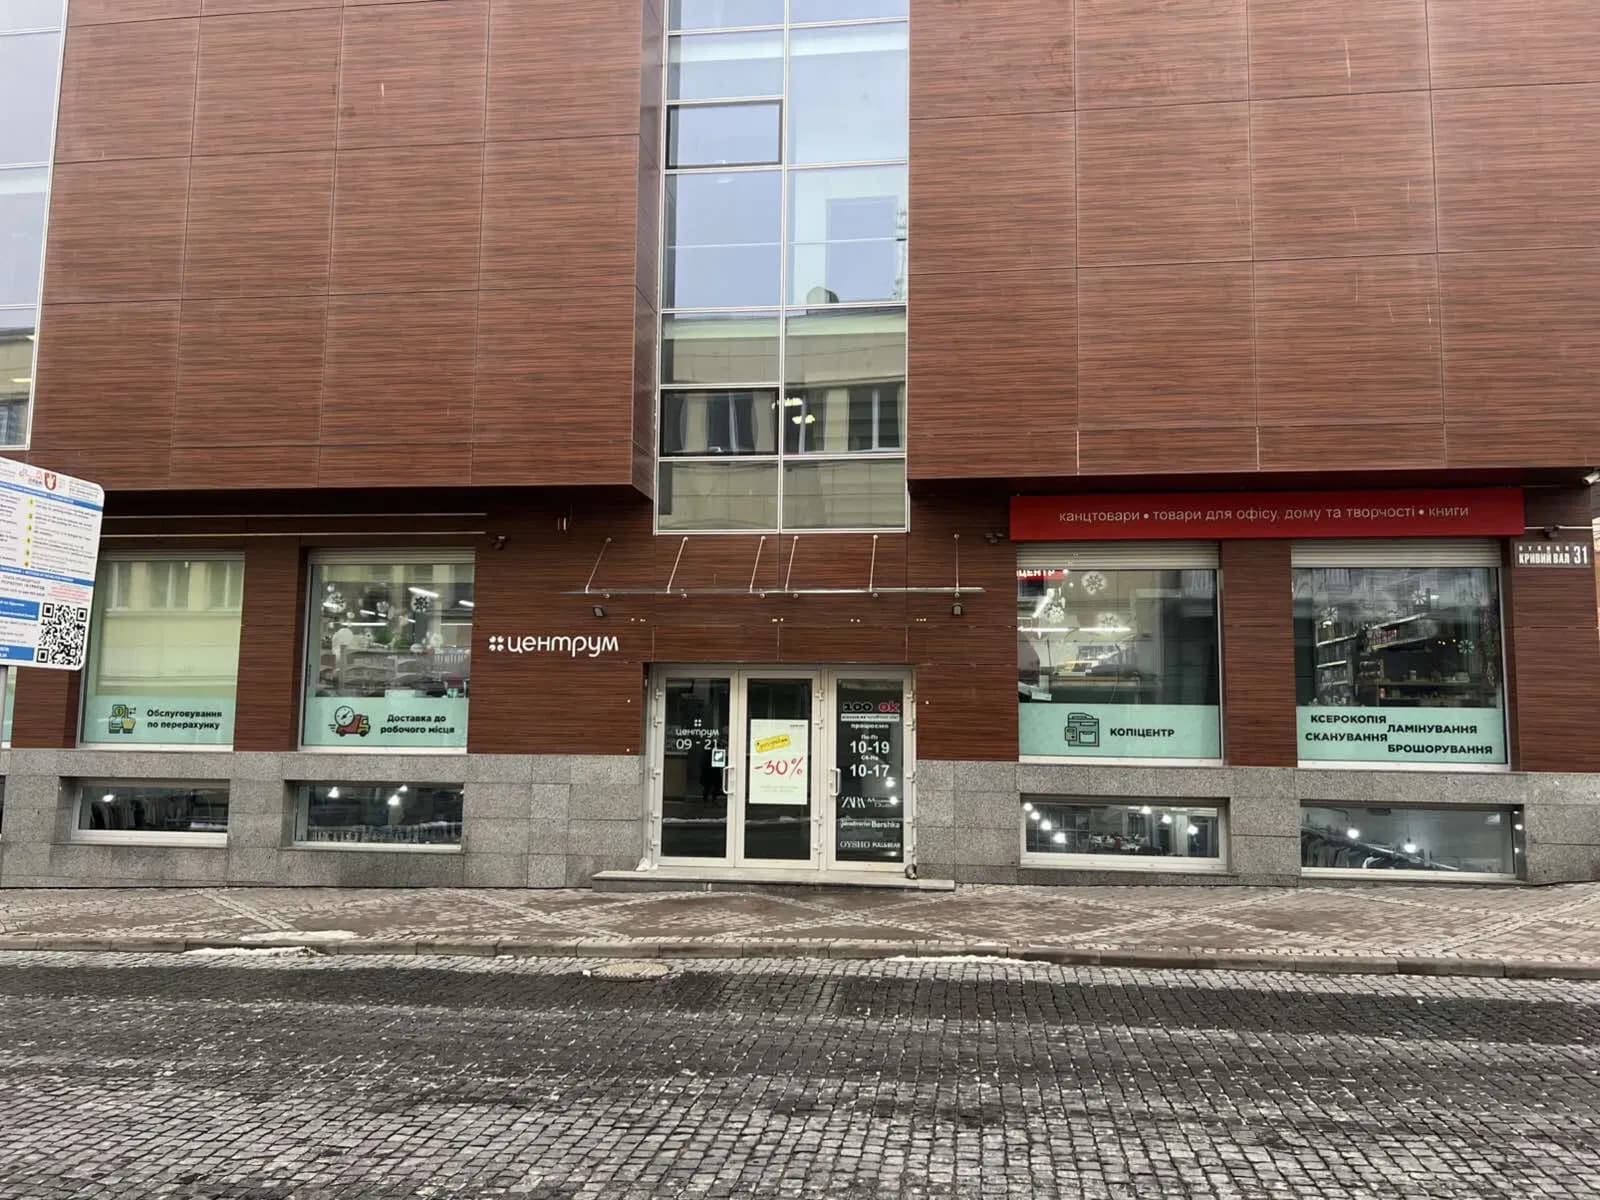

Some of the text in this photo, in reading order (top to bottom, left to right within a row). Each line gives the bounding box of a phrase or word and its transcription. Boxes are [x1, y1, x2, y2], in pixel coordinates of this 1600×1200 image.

[1059, 511, 1140, 523] канцтовари
[1153, 510, 1201, 522] товари
[1205, 509, 1232, 520] для
[1284, 508, 1321, 521] дому
[1326, 507, 1342, 518] та
[1347, 506, 1416, 520] творчості
[1428, 506, 1469, 518] книги
[1519, 545, 1588, 564] КРИВИЙ ВАЛ 31
[507, 636, 619, 657] центрум
[147, 709, 222, 718] Обслуговування
[387, 714, 447, 723] Доставка до
[1310, 715, 1387, 724] КСЕРОКОПІЯ
[160, 722, 220, 730] перерахунку
[380, 725, 455, 734] робочого місця
[1386, 725, 1478, 734] ЛАМІНУВАННЯ
[675, 729, 720, 738] центрум
[1110, 728, 1175, 738] КОПІЦЕНТР
[1305, 732, 1388, 742] СКАНУВАННЯ
[676, 738, 693, 750] 09
[703, 738, 718, 750] 21
[850, 741, 890, 754] 10-19
[1387, 744, 1493, 755] БРОШОРУВАННЯ
[850, 764, 890, 777] 10-17
